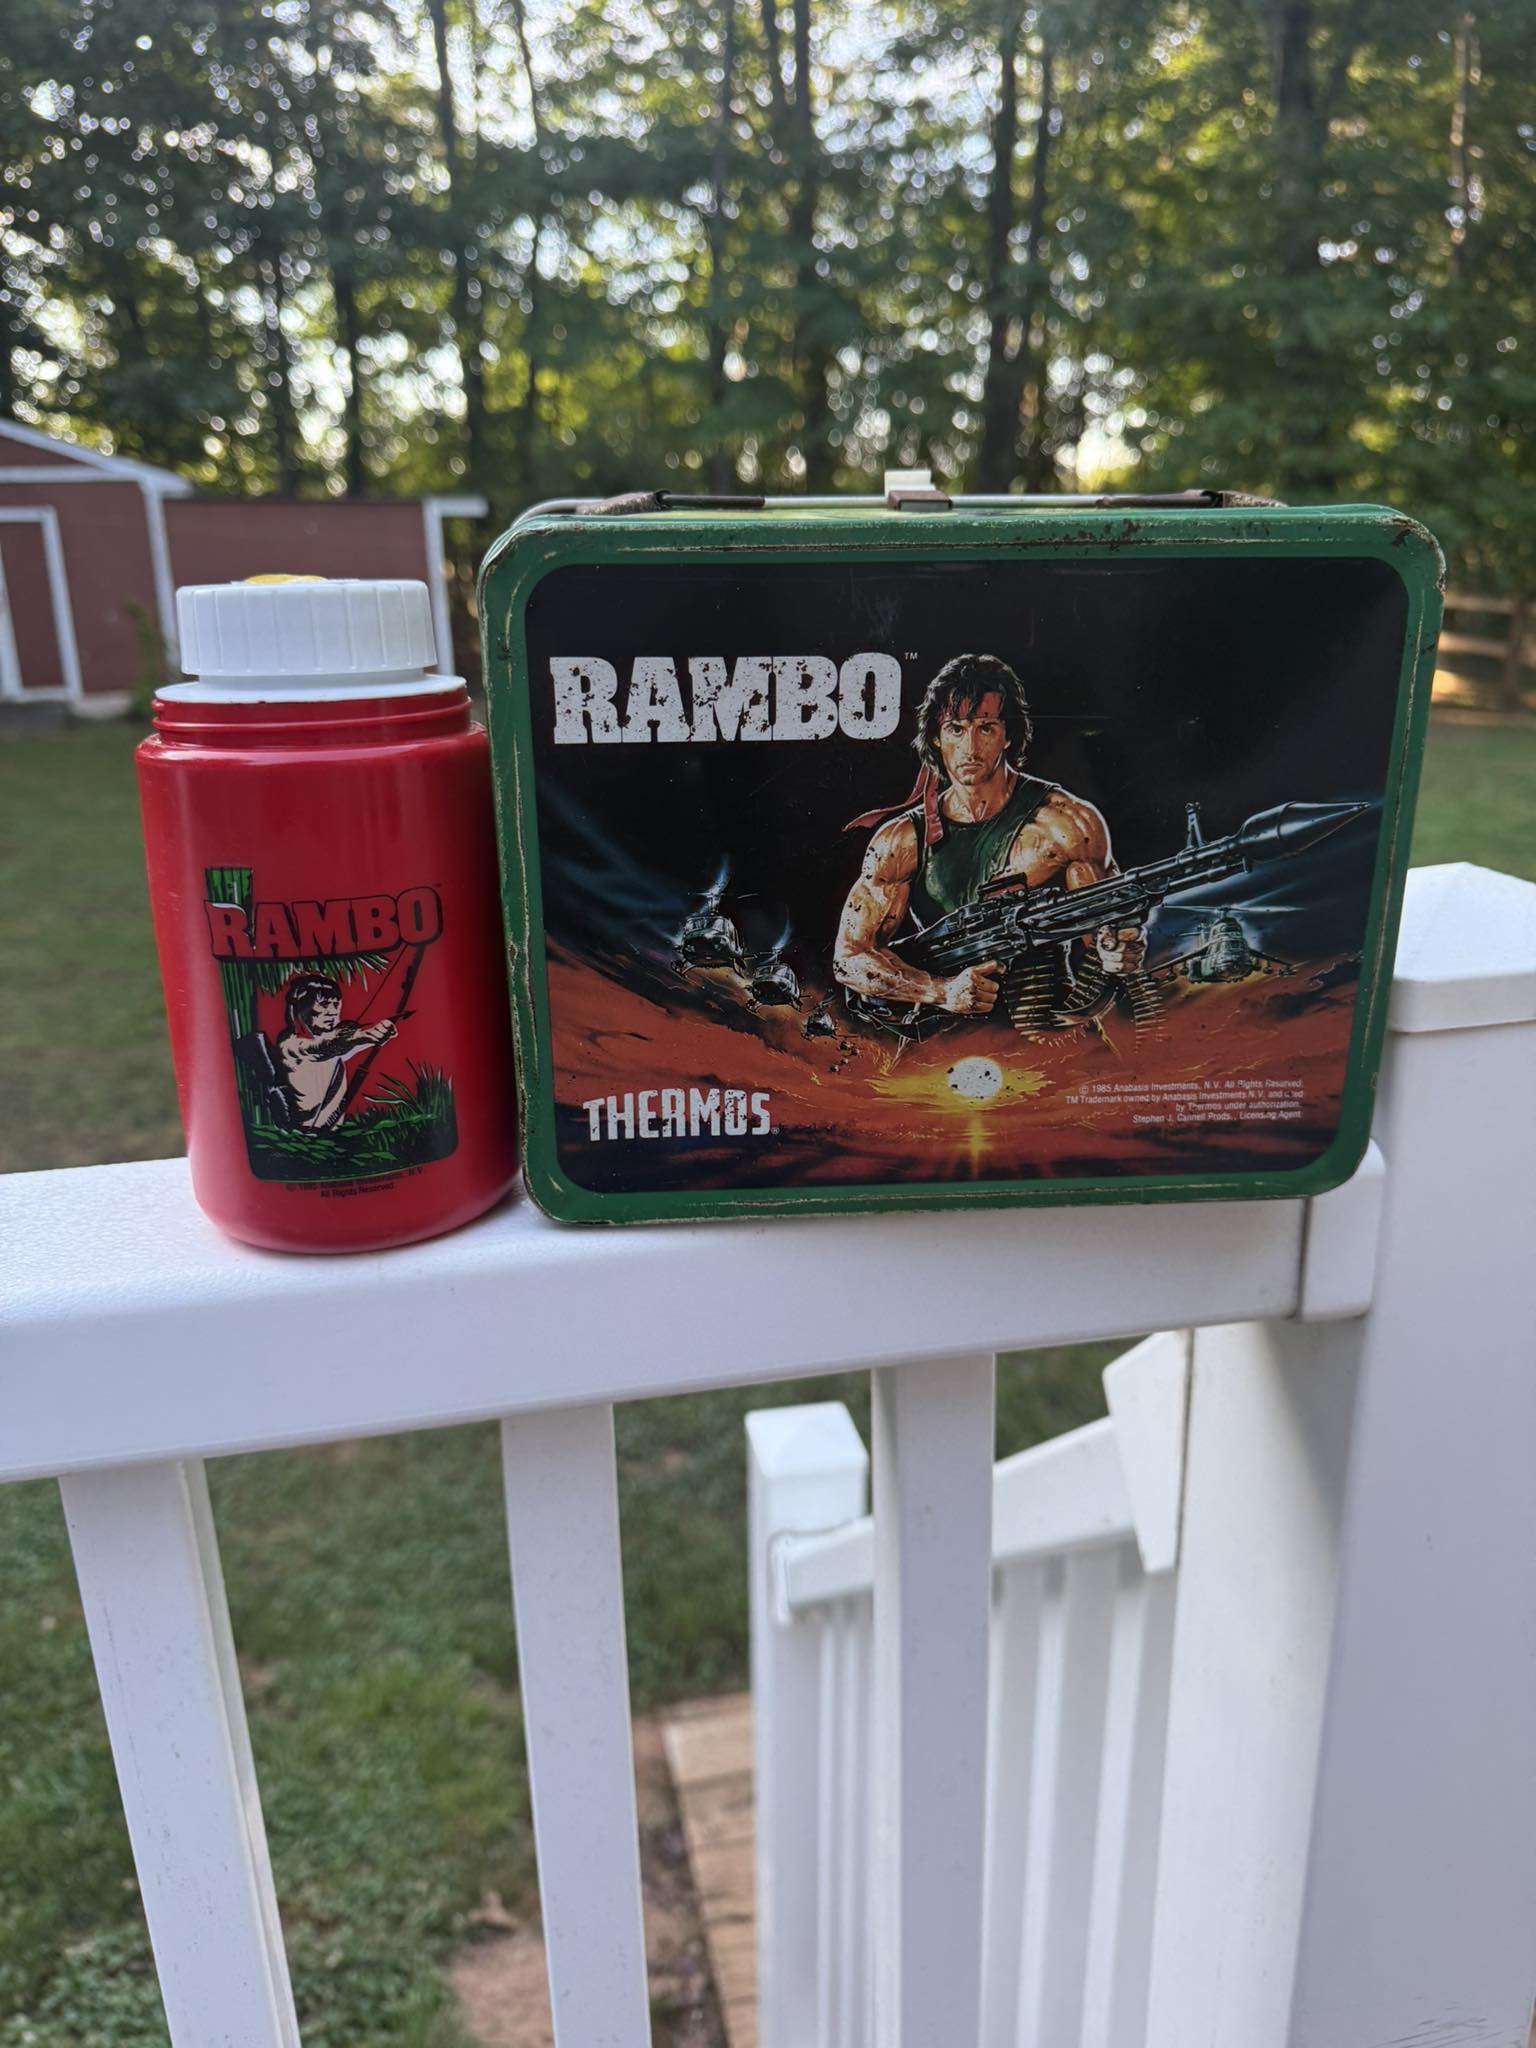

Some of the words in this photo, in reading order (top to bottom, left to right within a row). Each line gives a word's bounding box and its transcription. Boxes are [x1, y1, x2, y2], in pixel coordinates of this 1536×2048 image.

[549, 652, 902, 745] RAMBO
[204, 886, 443, 959] RAMBO
[1092, 1083, 1112, 1093] 1985
[1113, 1083, 1149, 1092] Anabasis
[1224, 1079, 1235, 1088] All
[1237, 1079, 1263, 1090] Rights
[1066, 1095, 1079, 1104] TM
[1080, 1094, 1122, 1104] Trademark
[1123, 1094, 1149, 1103] owned
[1150, 1094, 1160, 1104] by
[1162, 1092, 1197, 1102] Anabasis
[1199, 1091, 1247, 1100] Investments
[1268, 1090, 1282, 1099] and
[1175, 1103, 1185, 1112] by
[1188, 1102, 1222, 1111] Thermos
[1223, 1101, 1246, 1110] under
[583, 1087, 770, 1142] THERMOS
[1132, 1114, 1165, 1124] Stephen
[1176, 1111, 1206, 1122] Cannell
